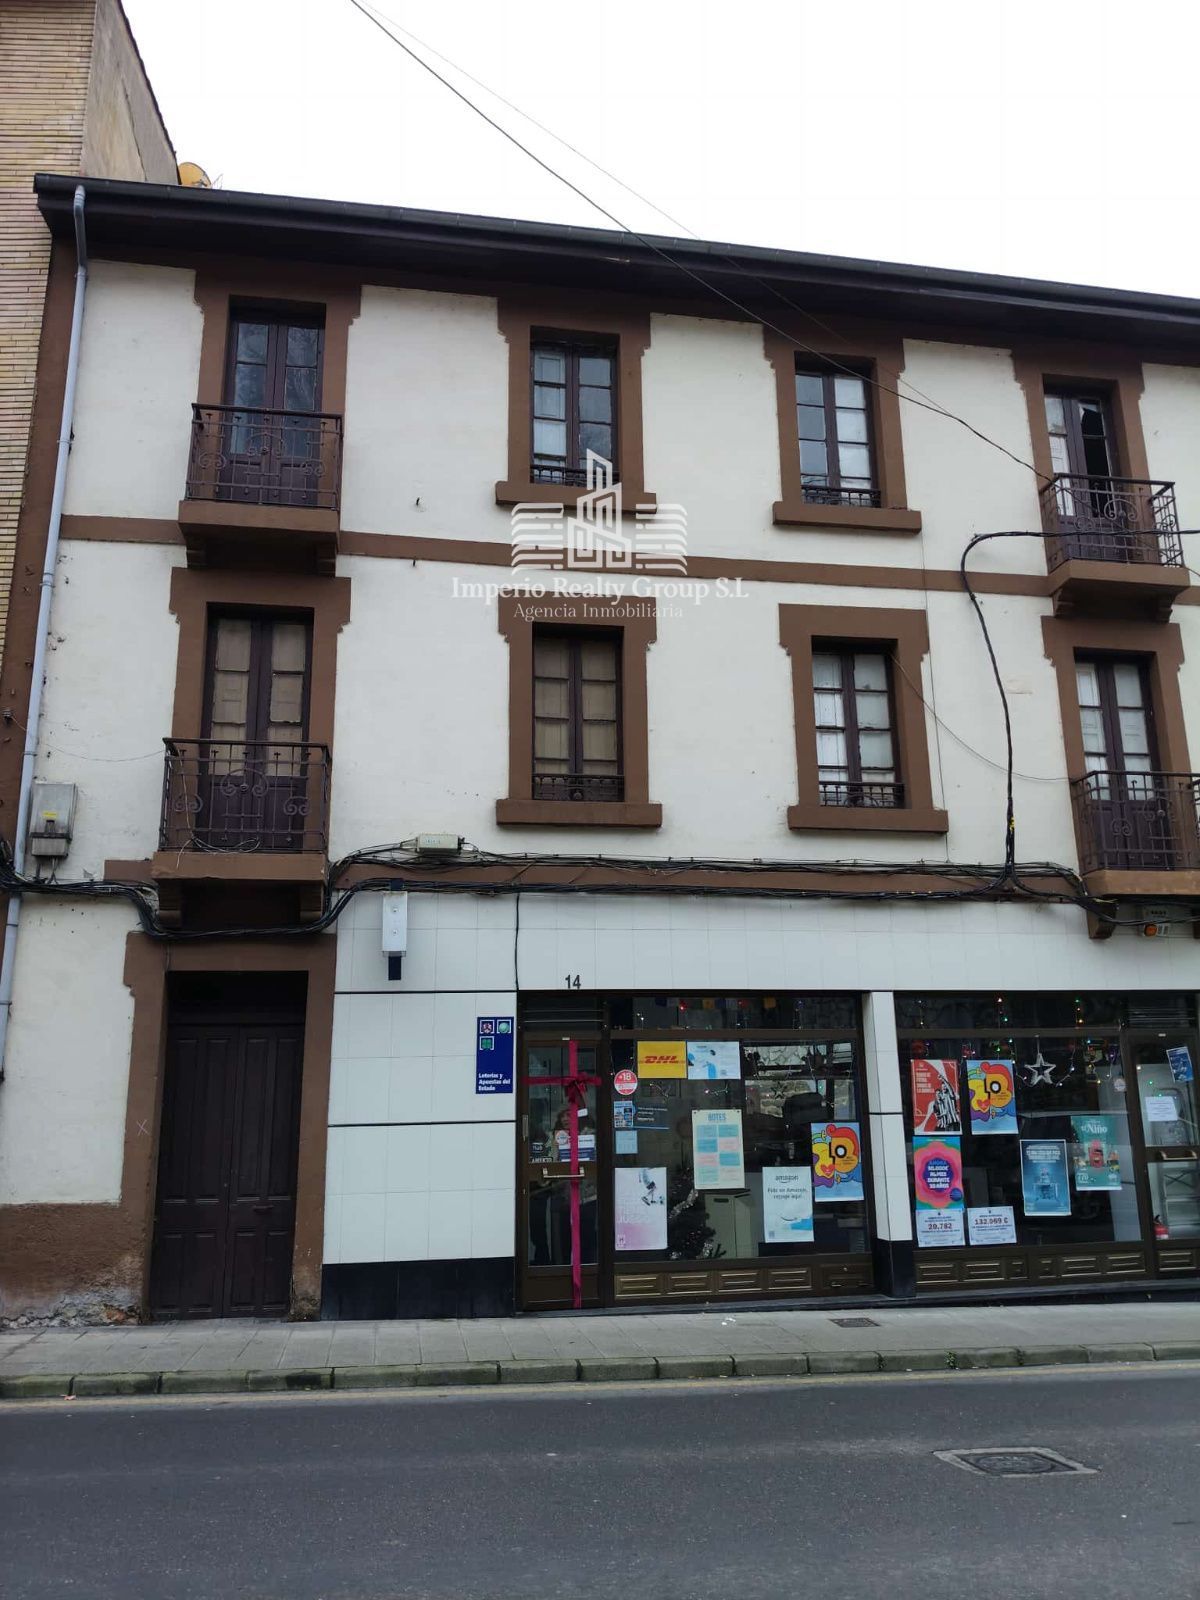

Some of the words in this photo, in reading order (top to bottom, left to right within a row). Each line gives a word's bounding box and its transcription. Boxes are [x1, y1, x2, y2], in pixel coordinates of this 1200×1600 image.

[565, 974, 582, 990] 14
[645, 1055, 678, 1064] DHL
[775, 1175, 799, 1183] amazon
